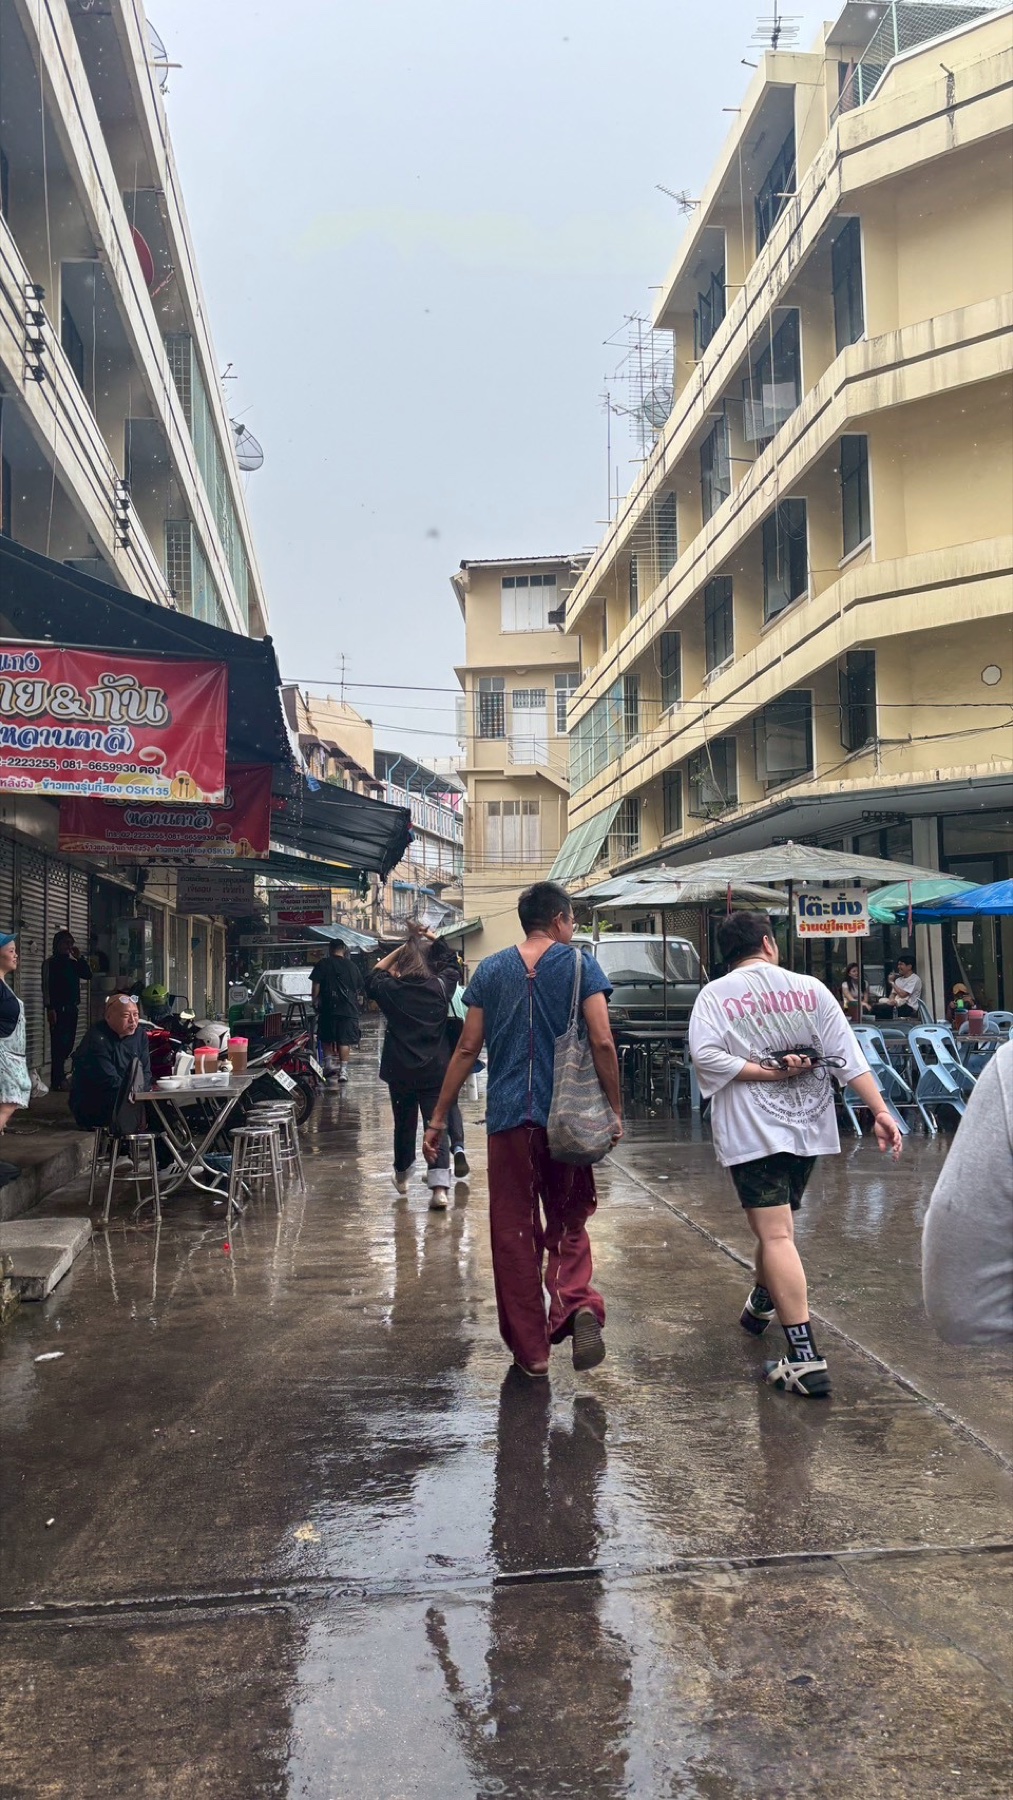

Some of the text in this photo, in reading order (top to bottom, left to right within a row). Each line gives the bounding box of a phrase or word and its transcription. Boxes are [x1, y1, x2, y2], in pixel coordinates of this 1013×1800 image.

[50, 684, 90, 718] &
[89, 674, 167, 723] กัน
[0, 726, 133, 752] หลานตาลี)
[0, 757, 58, 769] -2223255,
[62, 760, 137, 773] 081-6659930
[42, 778, 122, 793] ข้าวแกงรุ่นที่สอง
[125, 786, 169, 796] OSK135
[125, 810, 213, 829] (หลานตาลี)
[207, 847, 235, 855] OSK135
[798, 893, 863, 916] โต๊ะนั่ง
[799, 919, 866, 934] ร้านผู้ใหญ่ลี
